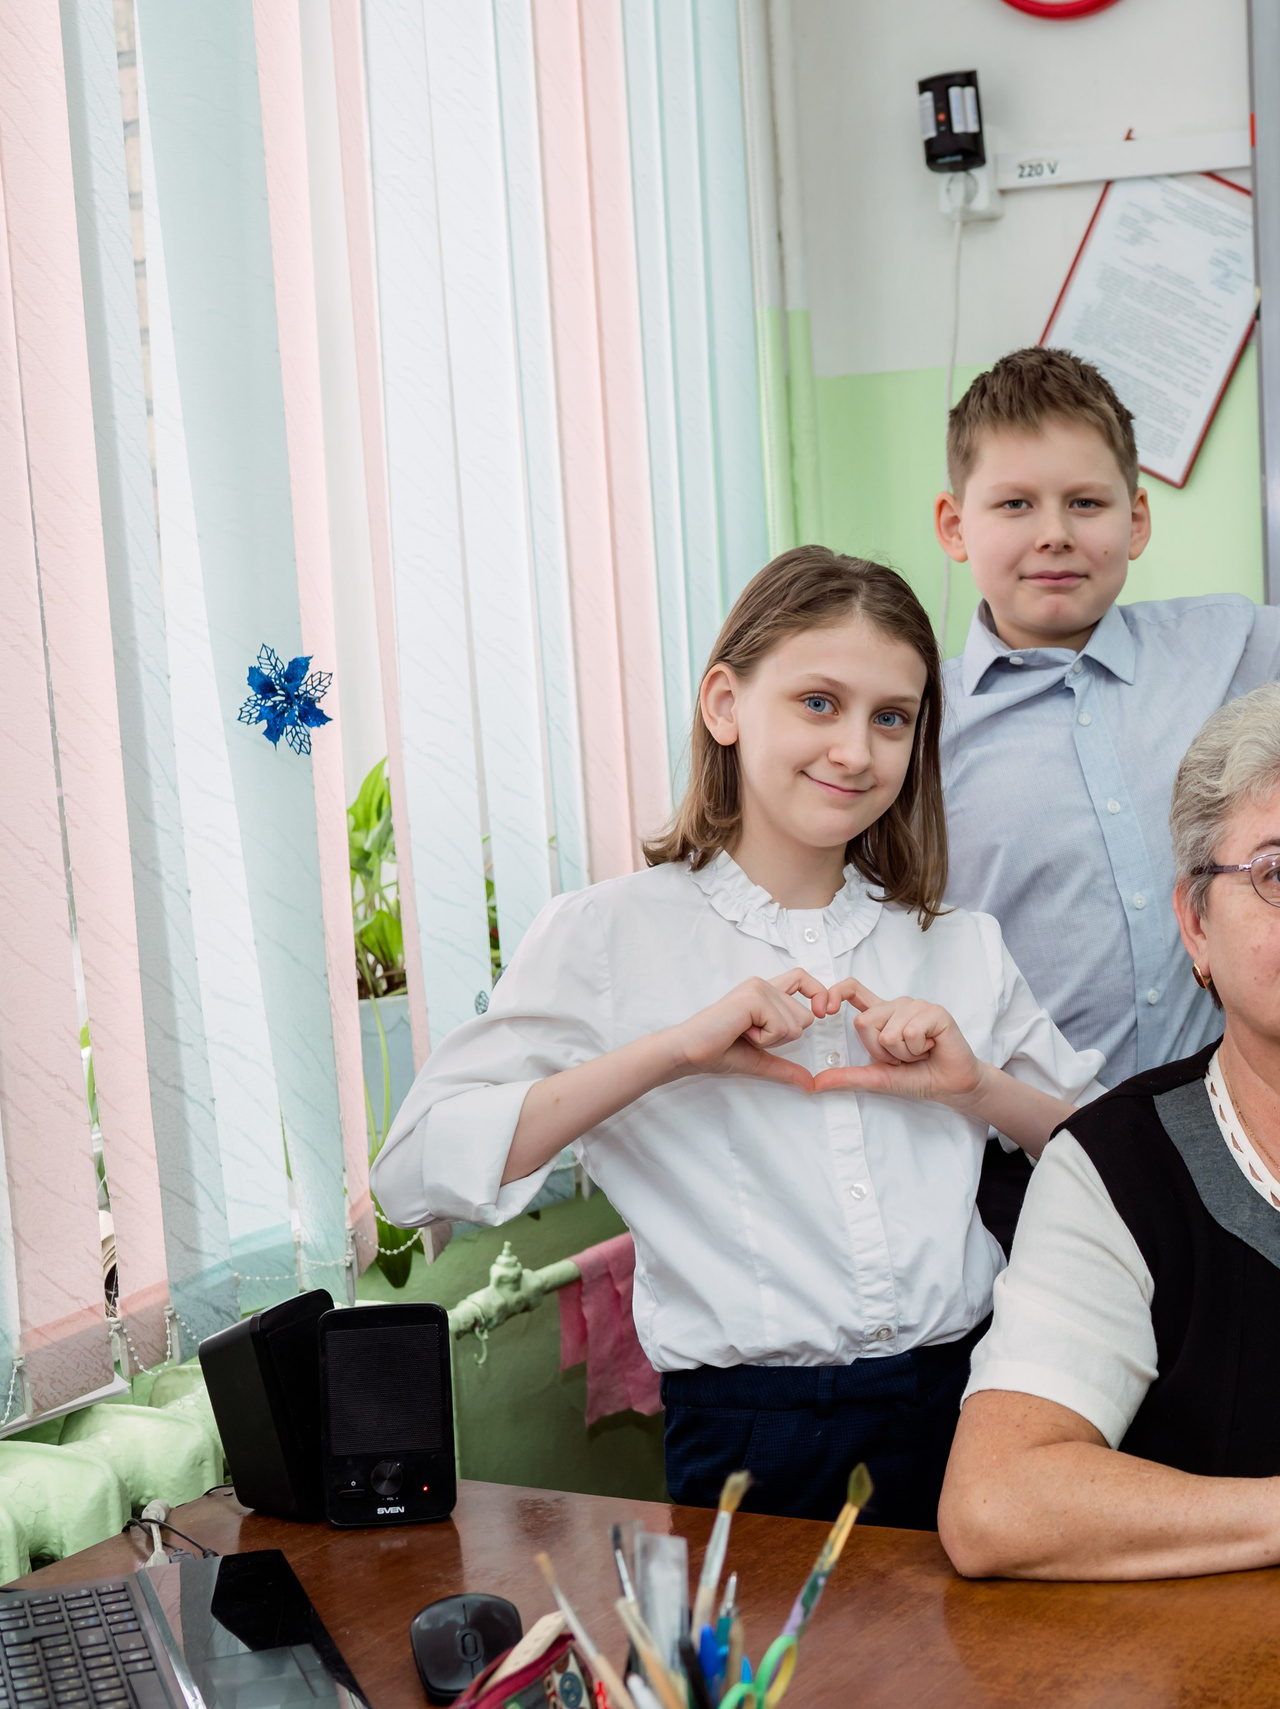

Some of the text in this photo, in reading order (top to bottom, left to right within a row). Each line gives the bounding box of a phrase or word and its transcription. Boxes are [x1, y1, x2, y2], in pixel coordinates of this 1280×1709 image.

[1017, 160, 1059, 178] 220 V
[377, 1506, 405, 1515] SVEN
